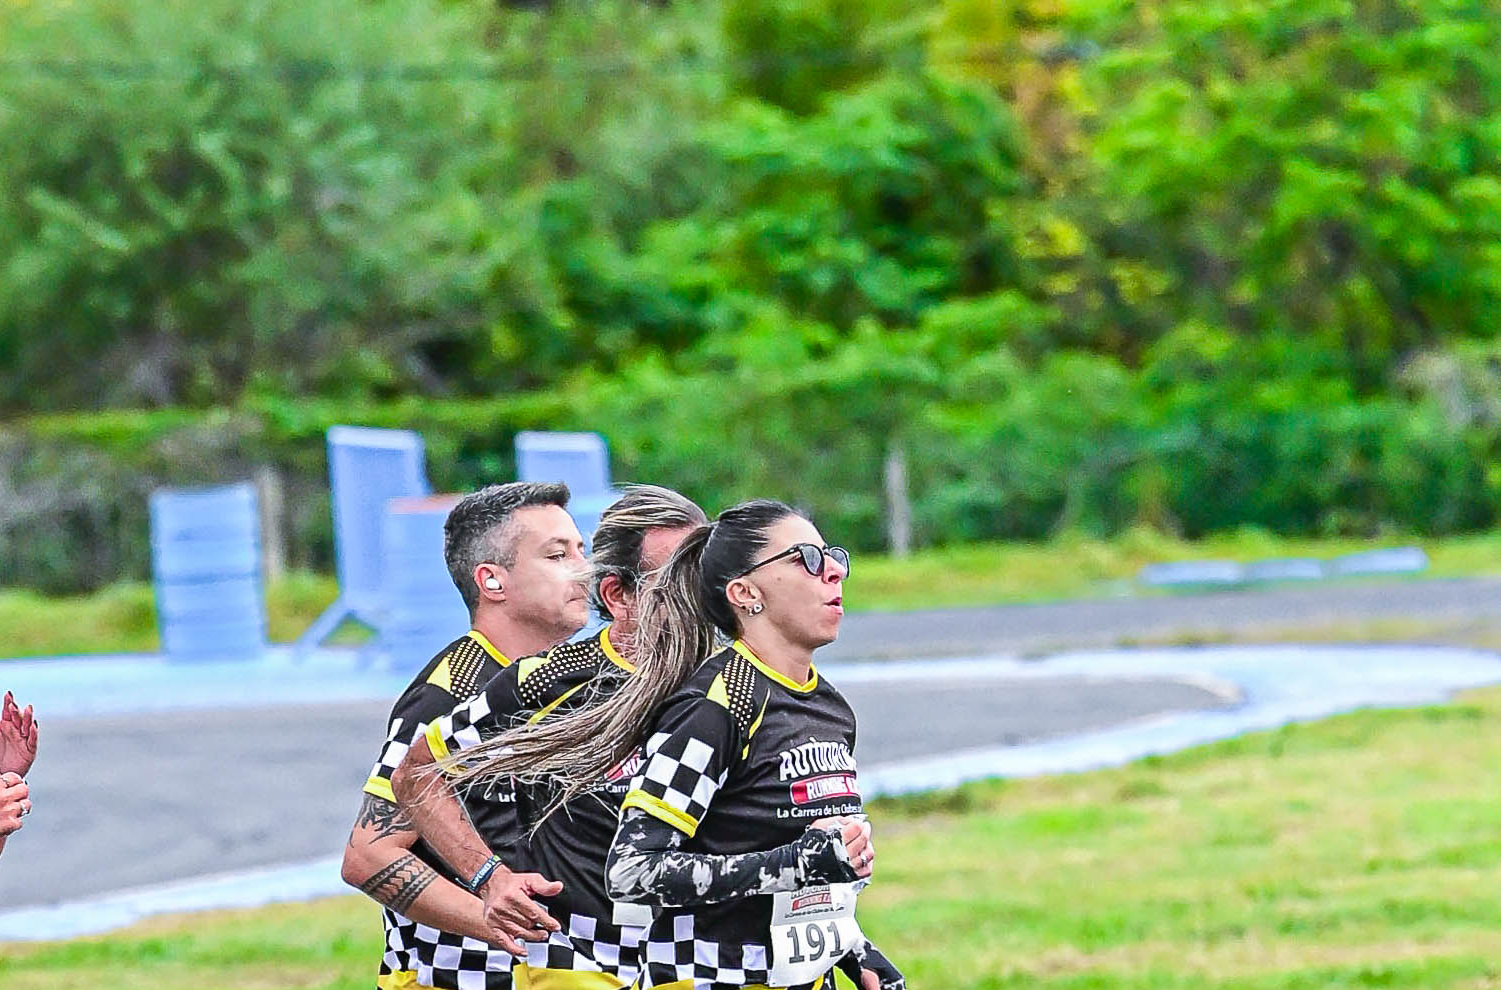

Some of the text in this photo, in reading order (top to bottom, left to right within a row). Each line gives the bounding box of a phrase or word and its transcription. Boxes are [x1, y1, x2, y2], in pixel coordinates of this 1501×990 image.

[605, 783, 629, 793] Carr
[777, 808, 790, 818] La
[791, 807, 823, 818] Carrera
[823, 804, 832, 815] de
[786, 921, 844, 964] 191
